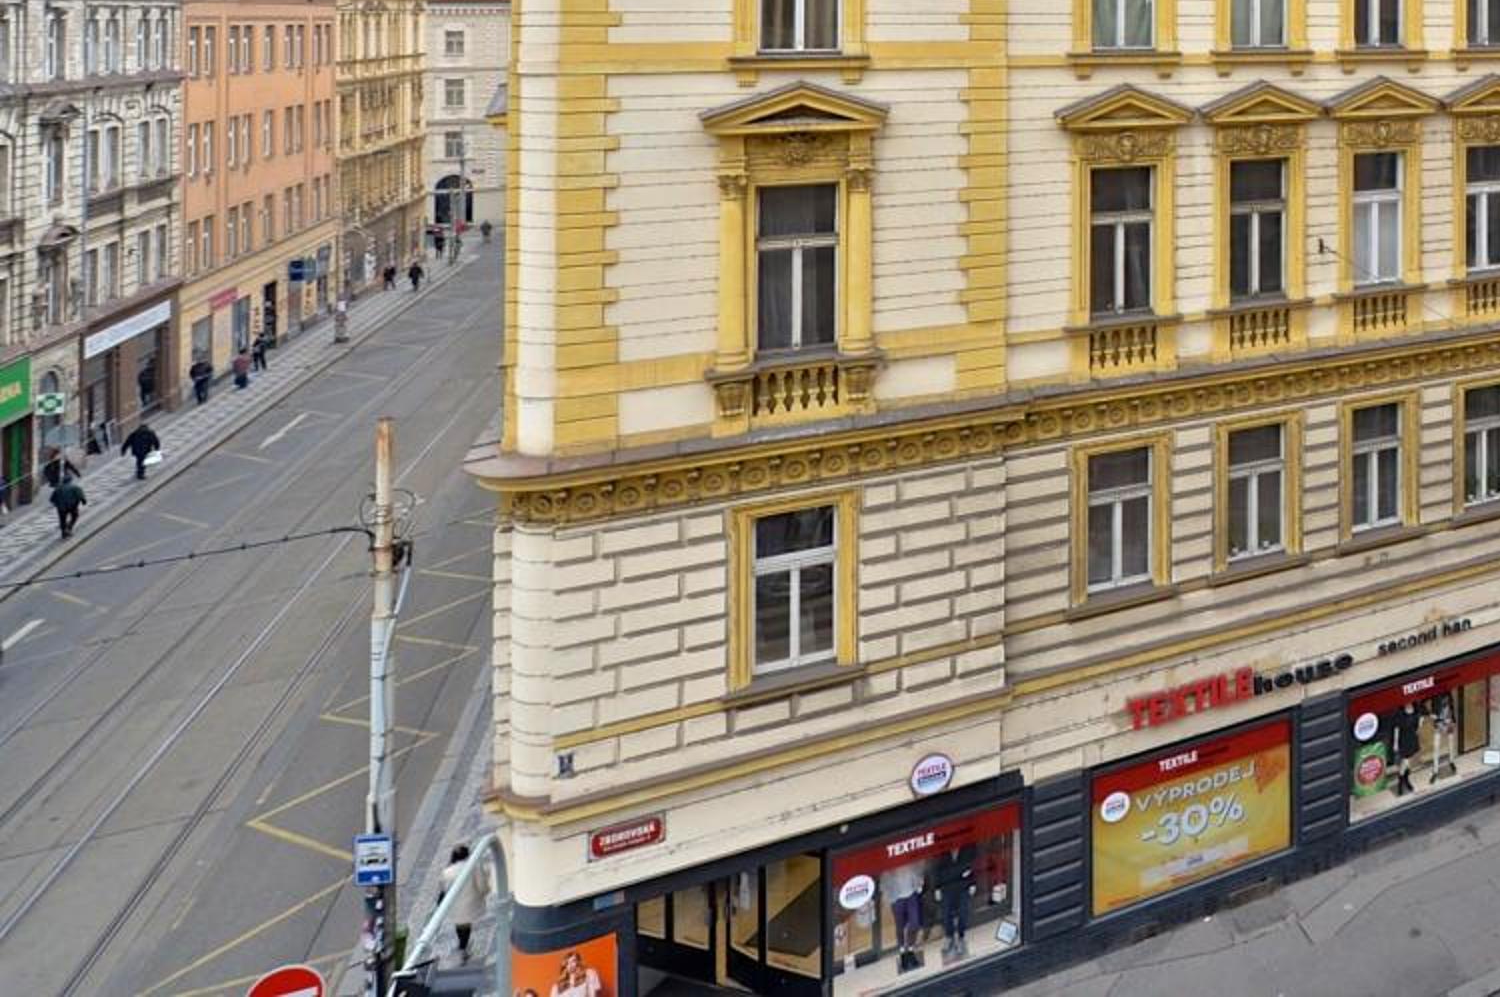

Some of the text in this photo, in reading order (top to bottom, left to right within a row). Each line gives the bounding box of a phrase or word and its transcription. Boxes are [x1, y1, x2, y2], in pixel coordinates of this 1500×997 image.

[1378, 624, 1437, 656] second
[1126, 666, 1253, 731] TEXTILE
[1159, 750, 1199, 771] TEXTILE
[1139, 793, 1245, 845] -30%
[886, 832, 935, 857] TEXTILE
